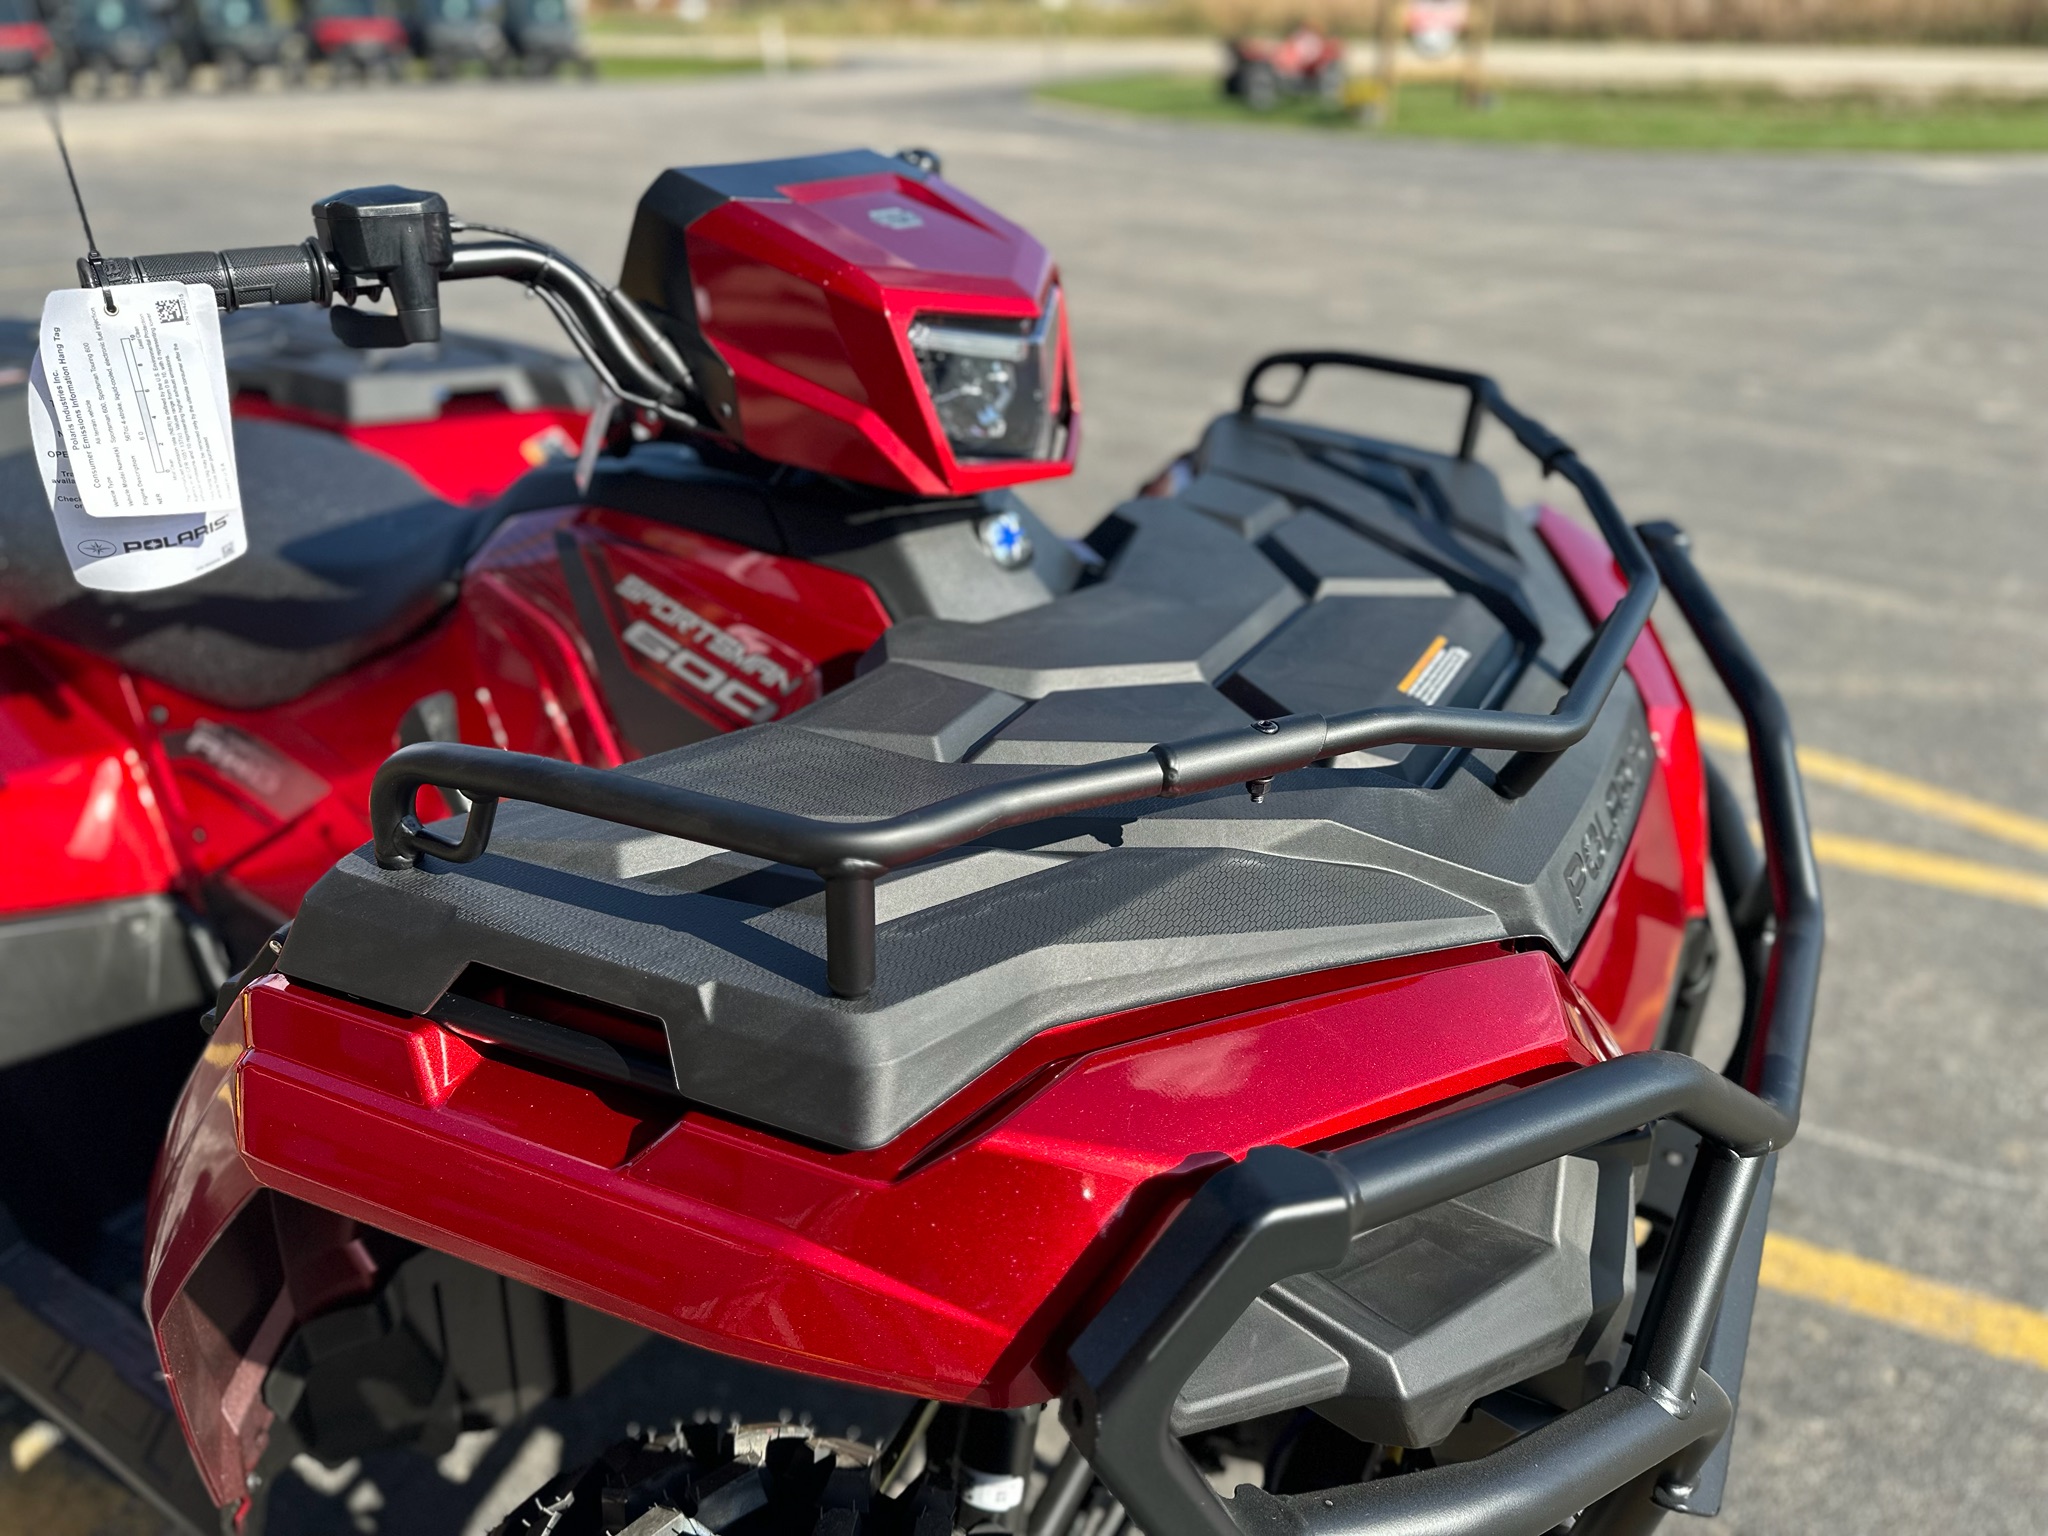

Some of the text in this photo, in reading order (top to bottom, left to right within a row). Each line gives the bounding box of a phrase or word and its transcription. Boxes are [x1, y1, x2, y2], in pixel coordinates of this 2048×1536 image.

[89, 306, 101, 330] injection
[138, 312, 150, 339] Protection
[95, 330, 104, 341] fuel
[128, 333, 136, 342] 10
[150, 327, 162, 356] representing
[82, 341, 91, 353] 600
[99, 341, 111, 367] electronic
[145, 338, 159, 371] Environmental
[174, 351, 182, 362] after
[86, 353, 97, 373] Touring
[51, 369, 61, 384] Inc.
[177, 362, 188, 385] consumer
[92, 372, 105, 401] Sportsman
[170, 378, 179, 398] exhaust
[183, 385, 192, 405] ultimate
[52, 326, 102, 489] Consumer Emissions Information Hang Tag
[55, 384, 72, 422] Industries
[84, 399, 94, 418] vehicle
[175, 397, 183, 413] higher
[90, 418, 99, 437] terrain
[104, 413, 117, 444] Sportsman
[122, 424, 132, 442] 567cc
[179, 413, 190, 443] representing
[191, 419, 199, 430] only
[67, 423, 80, 451] Polaris
[111, 446, 123, 471] Name(s)
[118, 470, 128, 488] Model
[130, 454, 143, 488] Description
[106, 476, 114, 489] Type
[109, 489, 120, 508] Vehicle
[124, 488, 134, 507] Vehicle
[139, 487, 149, 506] Engine
[154, 492, 163, 505] NER
[123, 518, 228, 553] POLARIS
[614, 573, 802, 696] SPORTSMAN
[622, 619, 779, 724] 600
[1562, 730, 1646, 915] POLAR
